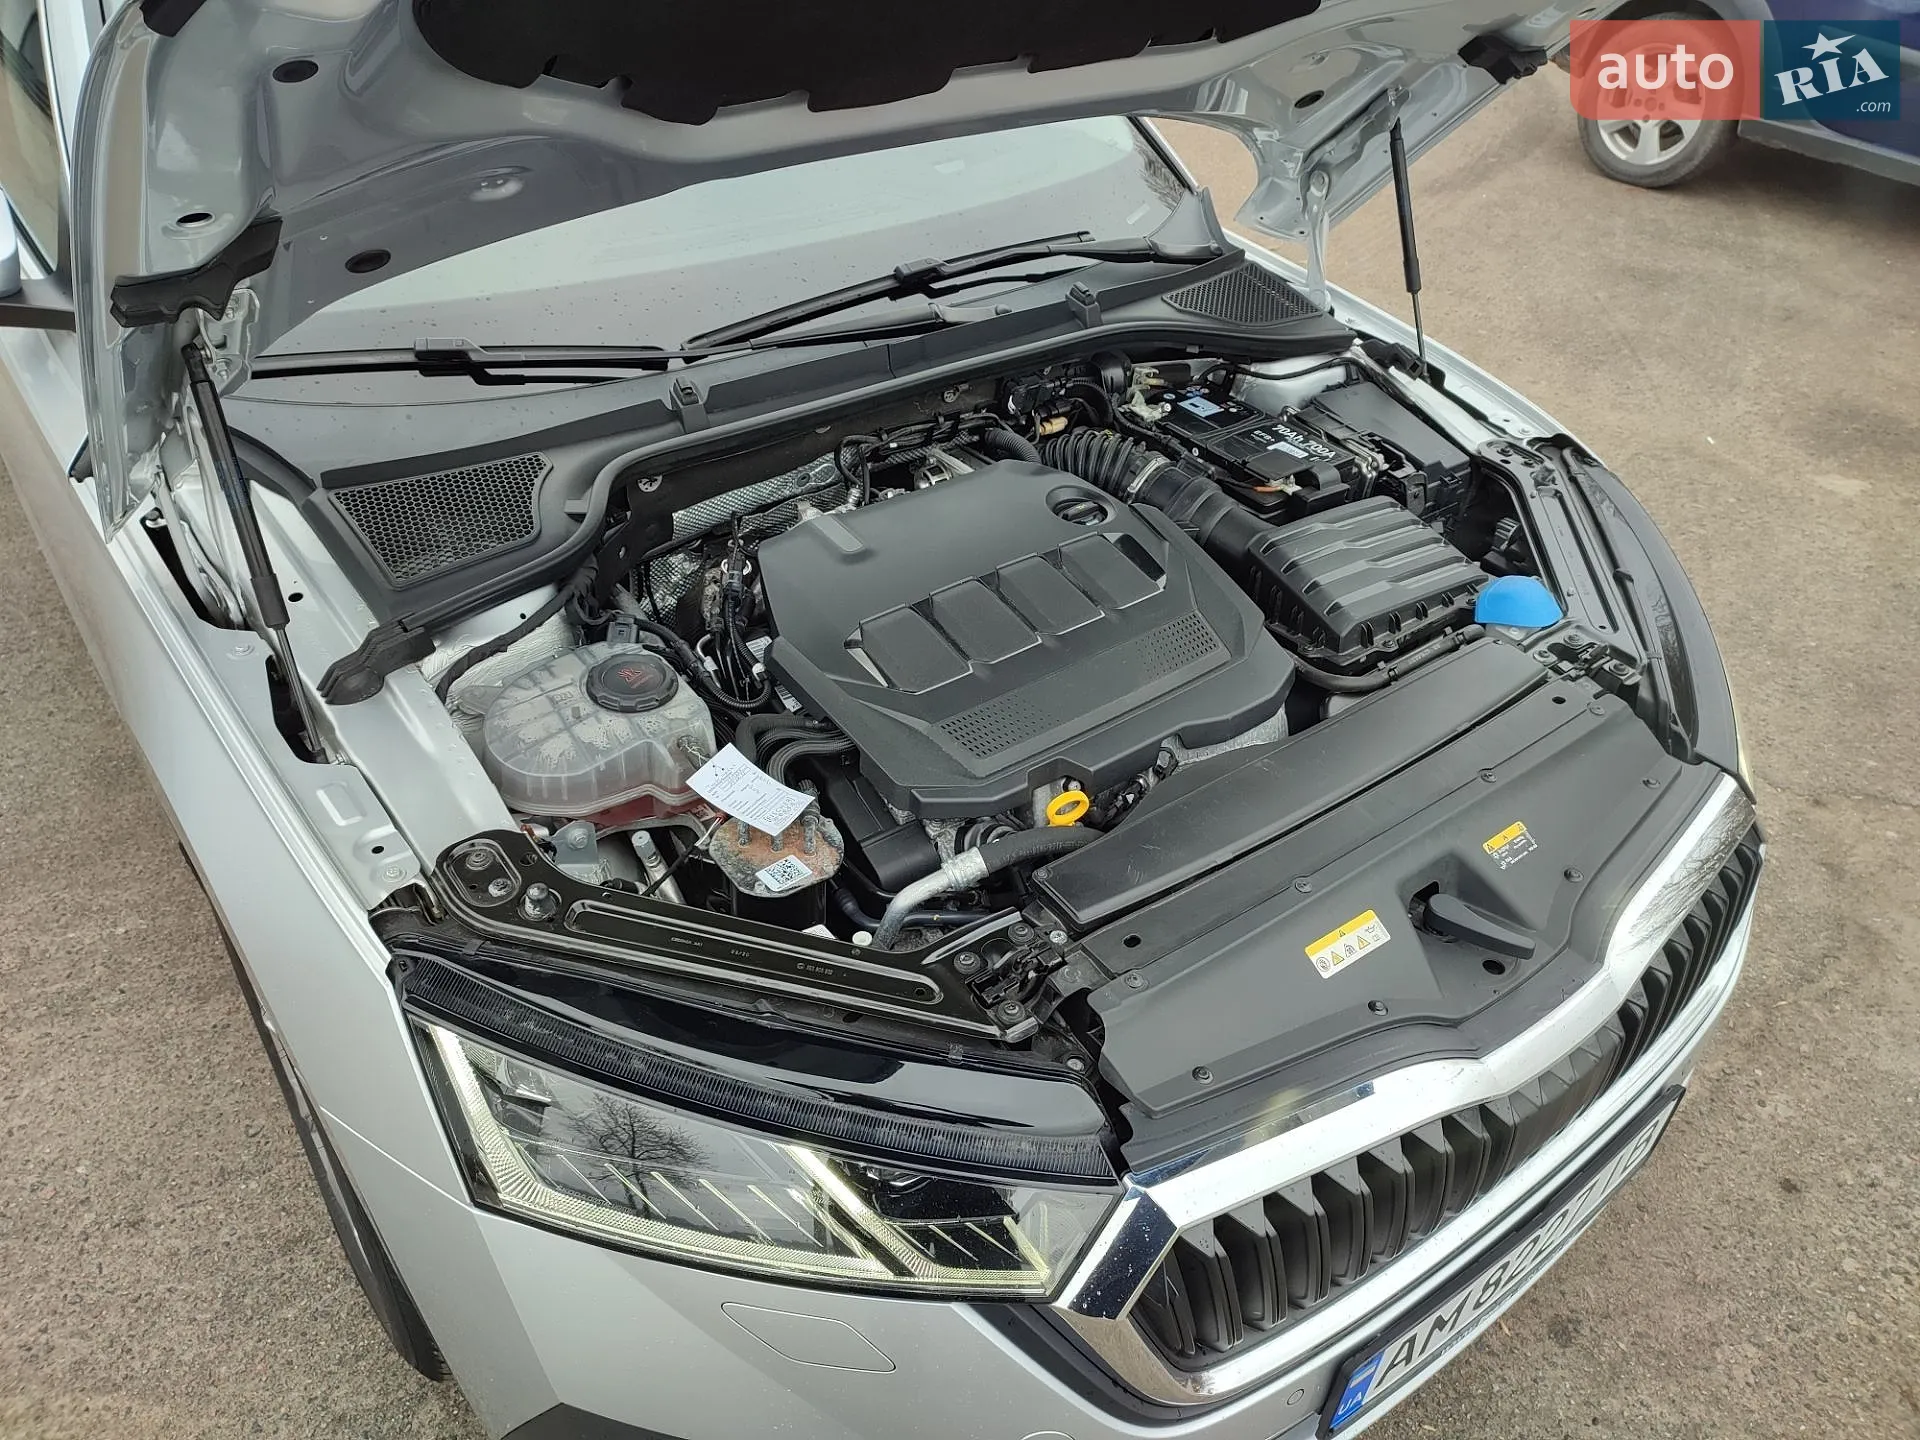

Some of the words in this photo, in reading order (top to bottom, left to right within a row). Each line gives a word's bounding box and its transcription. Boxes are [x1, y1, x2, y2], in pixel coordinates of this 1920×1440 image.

[1272, 424, 1304, 442] 70Ah
[1303, 440, 1336, 458] 700A
[1374, 1289, 1473, 1390] AM
[1472, 1178, 1600, 1310] 8227
[1338, 1392, 1362, 1415] UA
